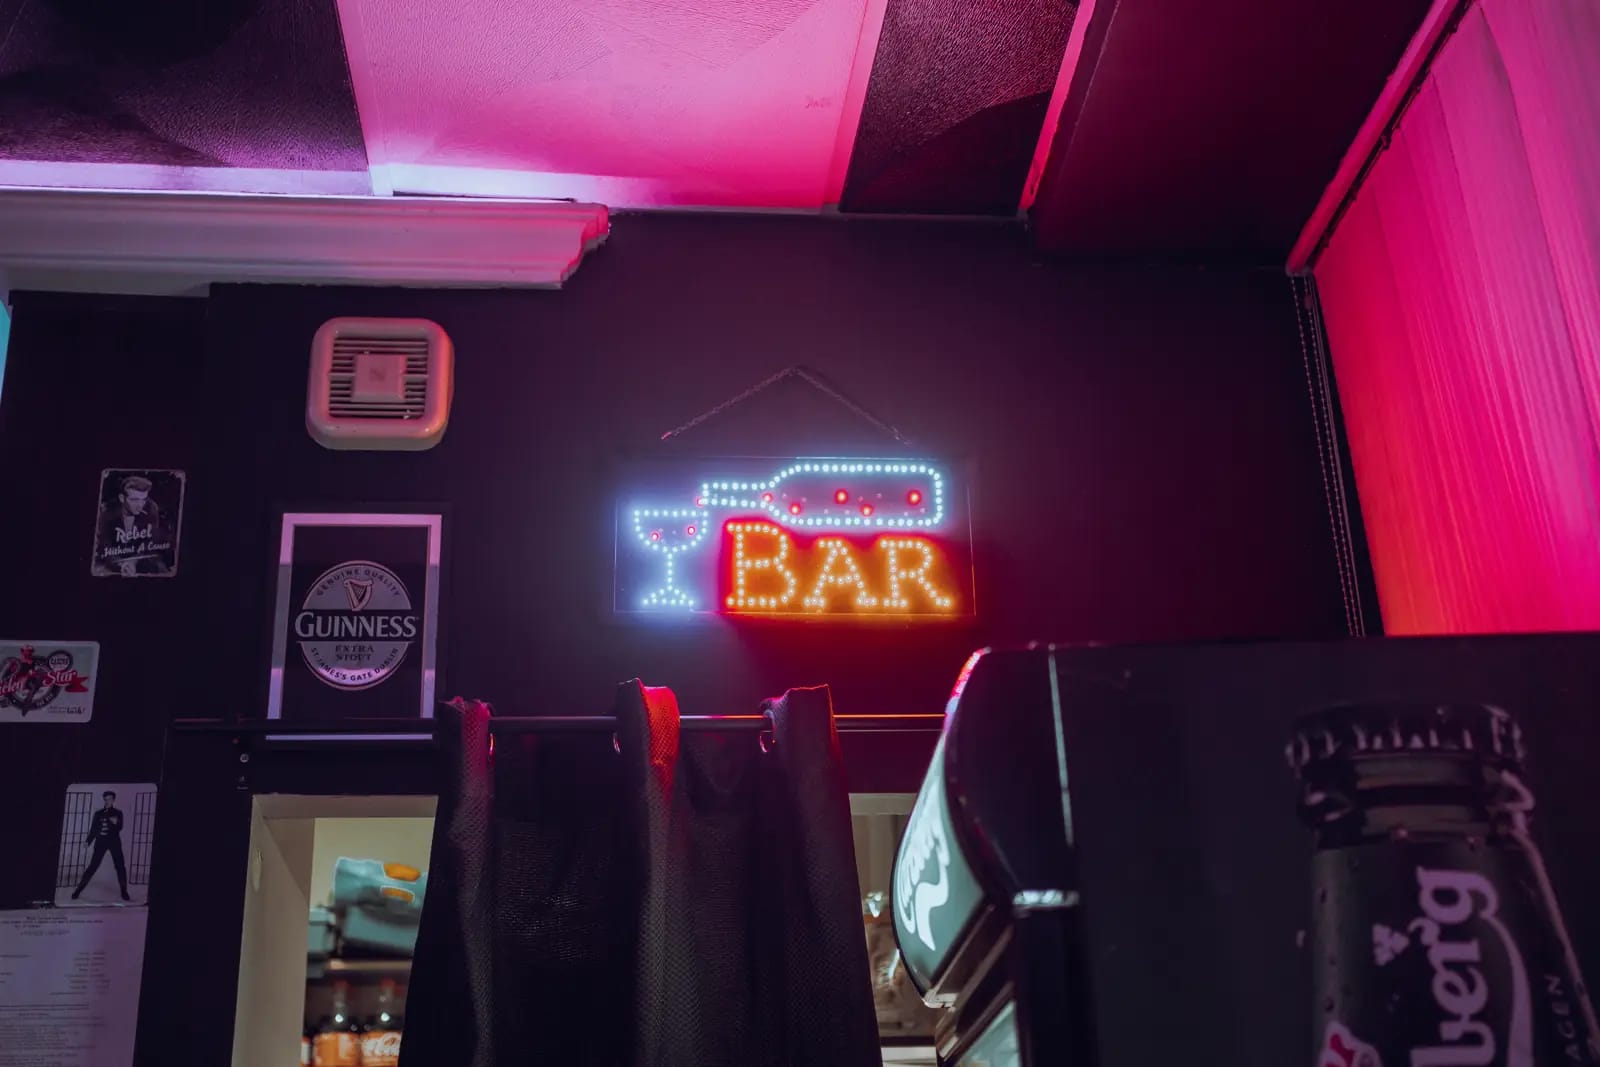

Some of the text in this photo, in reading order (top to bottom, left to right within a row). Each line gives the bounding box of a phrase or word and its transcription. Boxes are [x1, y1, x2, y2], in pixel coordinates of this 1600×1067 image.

[115, 523, 153, 543] Rebel
[103, 541, 171, 557] Without A Cause
[725, 523, 955, 607] BAR
[316, 568, 400, 597] GENUINE QUALITY
[294, 611, 417, 639] GUINNESS
[335, 644, 375, 653] EXTRA
[335, 654, 372, 662] STOUT
[349, 671, 373, 682] GATE
[374, 646, 398, 674] DUBLIN
[43, 668, 77, 687] Star
